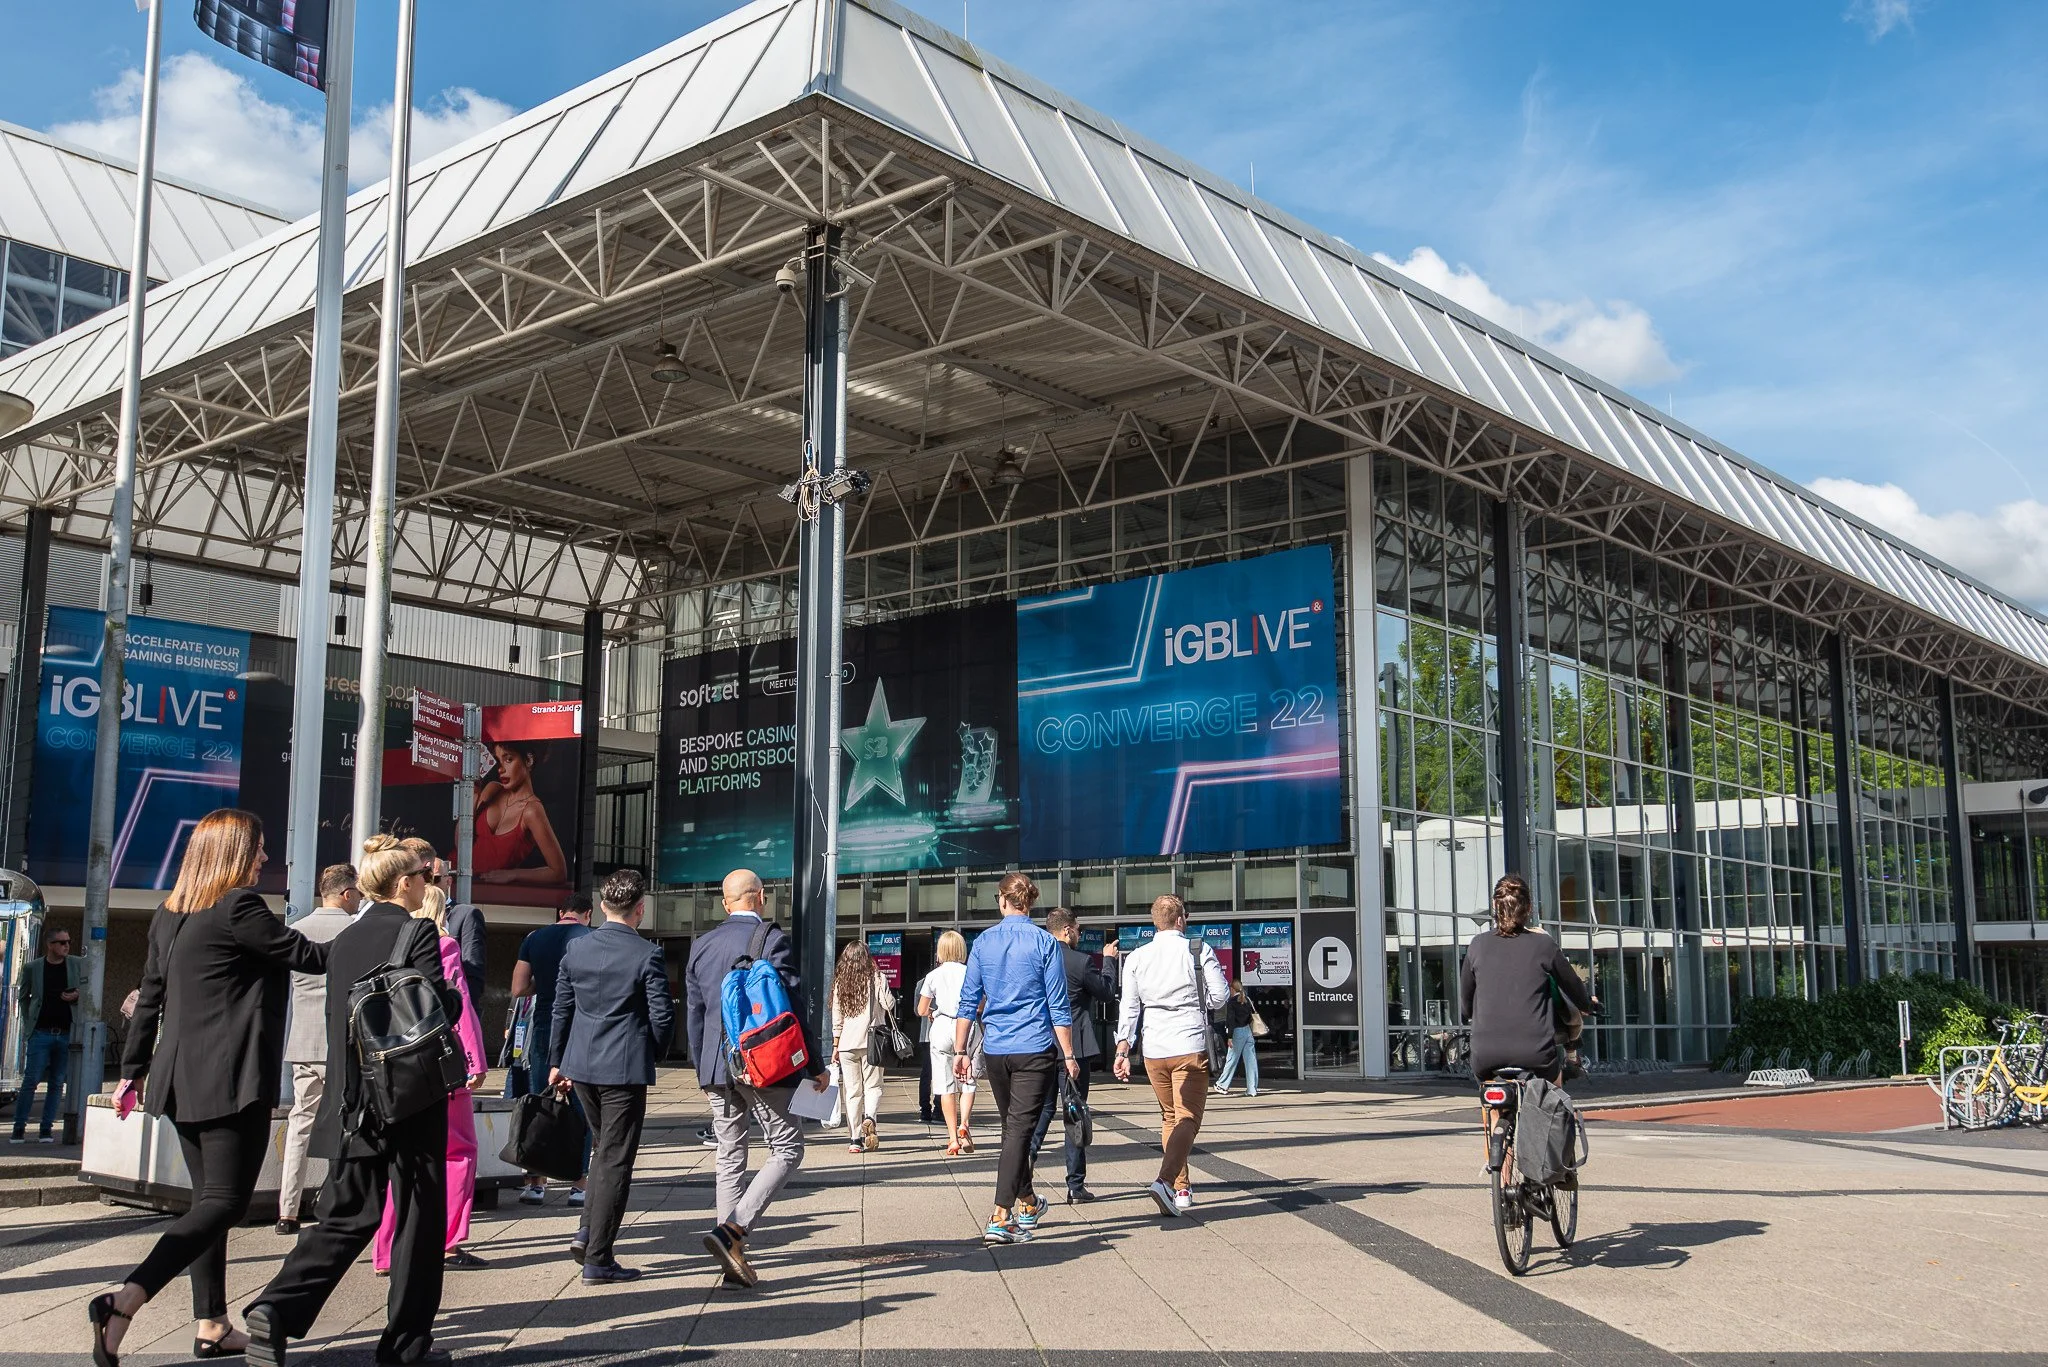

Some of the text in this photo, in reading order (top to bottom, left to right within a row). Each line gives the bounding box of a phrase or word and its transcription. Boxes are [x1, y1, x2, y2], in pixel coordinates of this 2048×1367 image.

[124, 633, 240, 658] ACCELERATE YOUR
[1163, 606, 1312, 667] iGBLIVE
[124, 648, 239, 672] GAMING BUSINESS!
[769, 678, 788, 690] MEET
[532, 704, 574, 714] Strand Zuid
[1036, 685, 1325, 753] CONVERGE 22
[201, 740, 233, 761] 22
[418, 732, 433, 746] Parking
[679, 731, 744, 755] BESPOKE
[678, 746, 796, 775] AND SPORTSBOO
[678, 771, 761, 796] PLATFORMS
[1322, 941, 1338, 980] F
[1308, 992, 1354, 1002] Entrance
